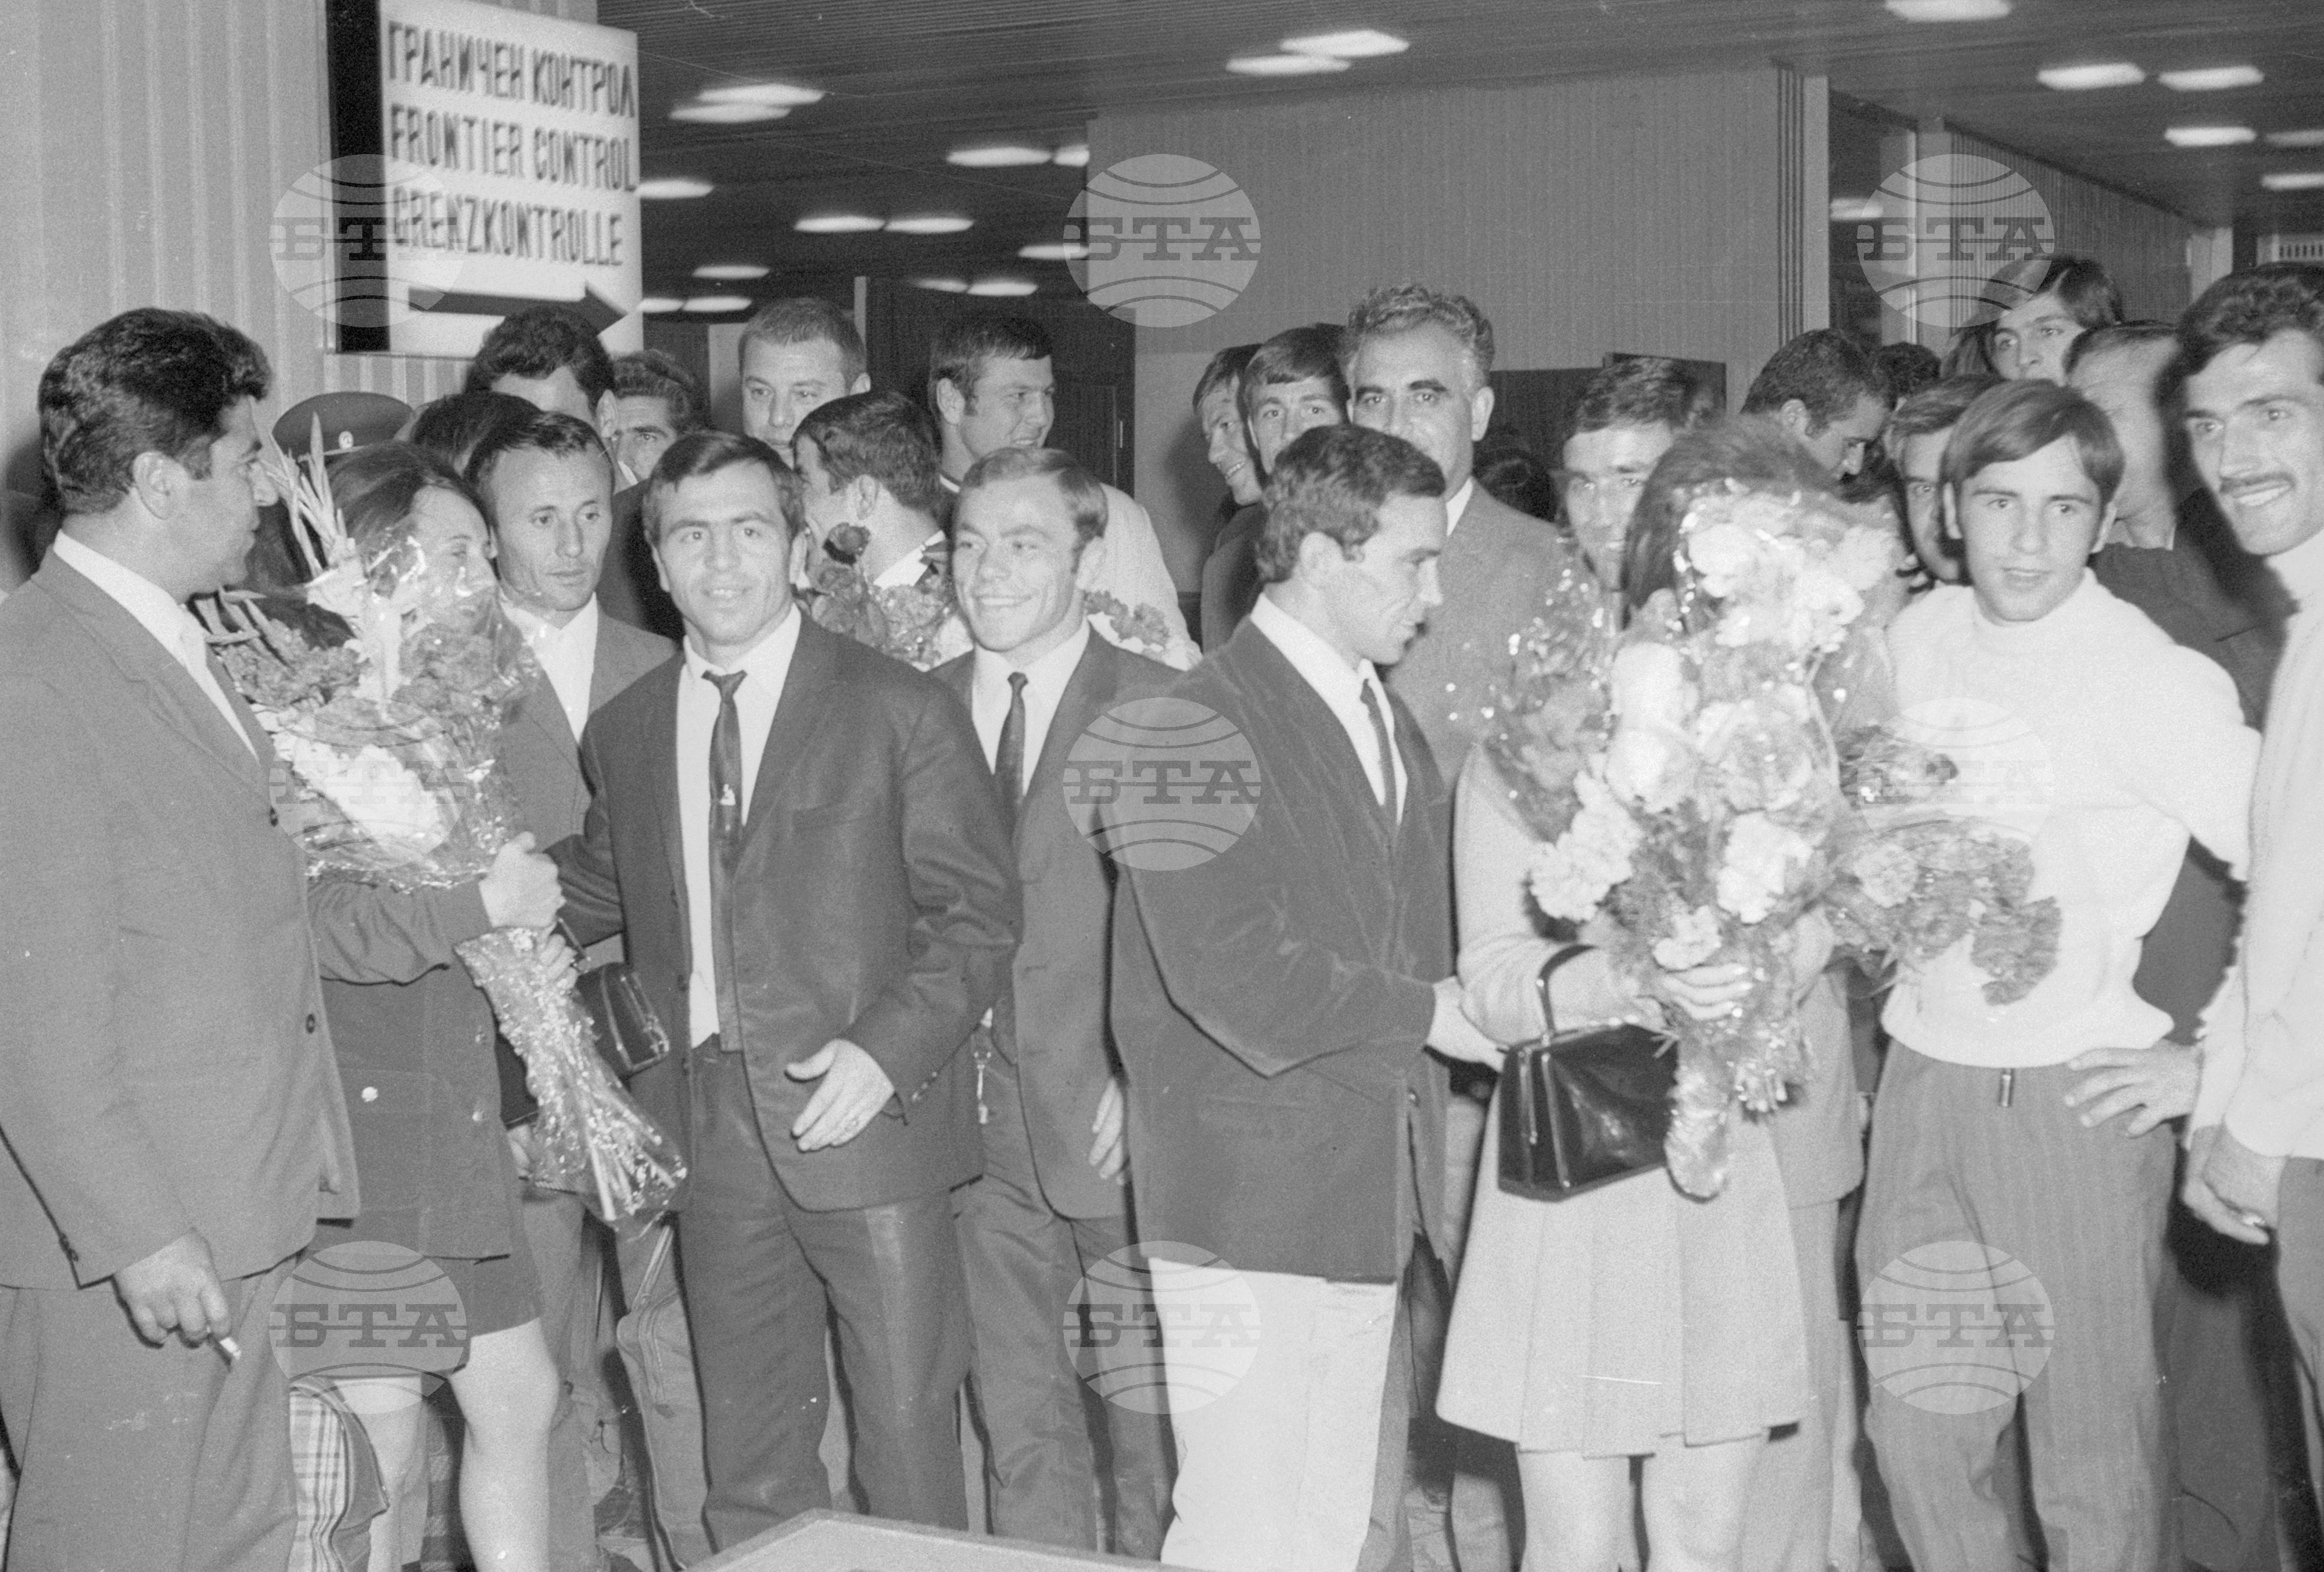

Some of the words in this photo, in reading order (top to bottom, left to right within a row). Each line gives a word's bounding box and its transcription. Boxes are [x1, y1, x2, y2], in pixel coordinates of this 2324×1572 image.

[389, 21, 524, 100] ГРАНИЧЕН
[532, 49, 635, 117] КОНТРОЛ
[392, 103, 521, 177] FRONTIER
[535, 127, 637, 192] CONTROL
[393, 185, 622, 266] GRENZKONTROLLE
